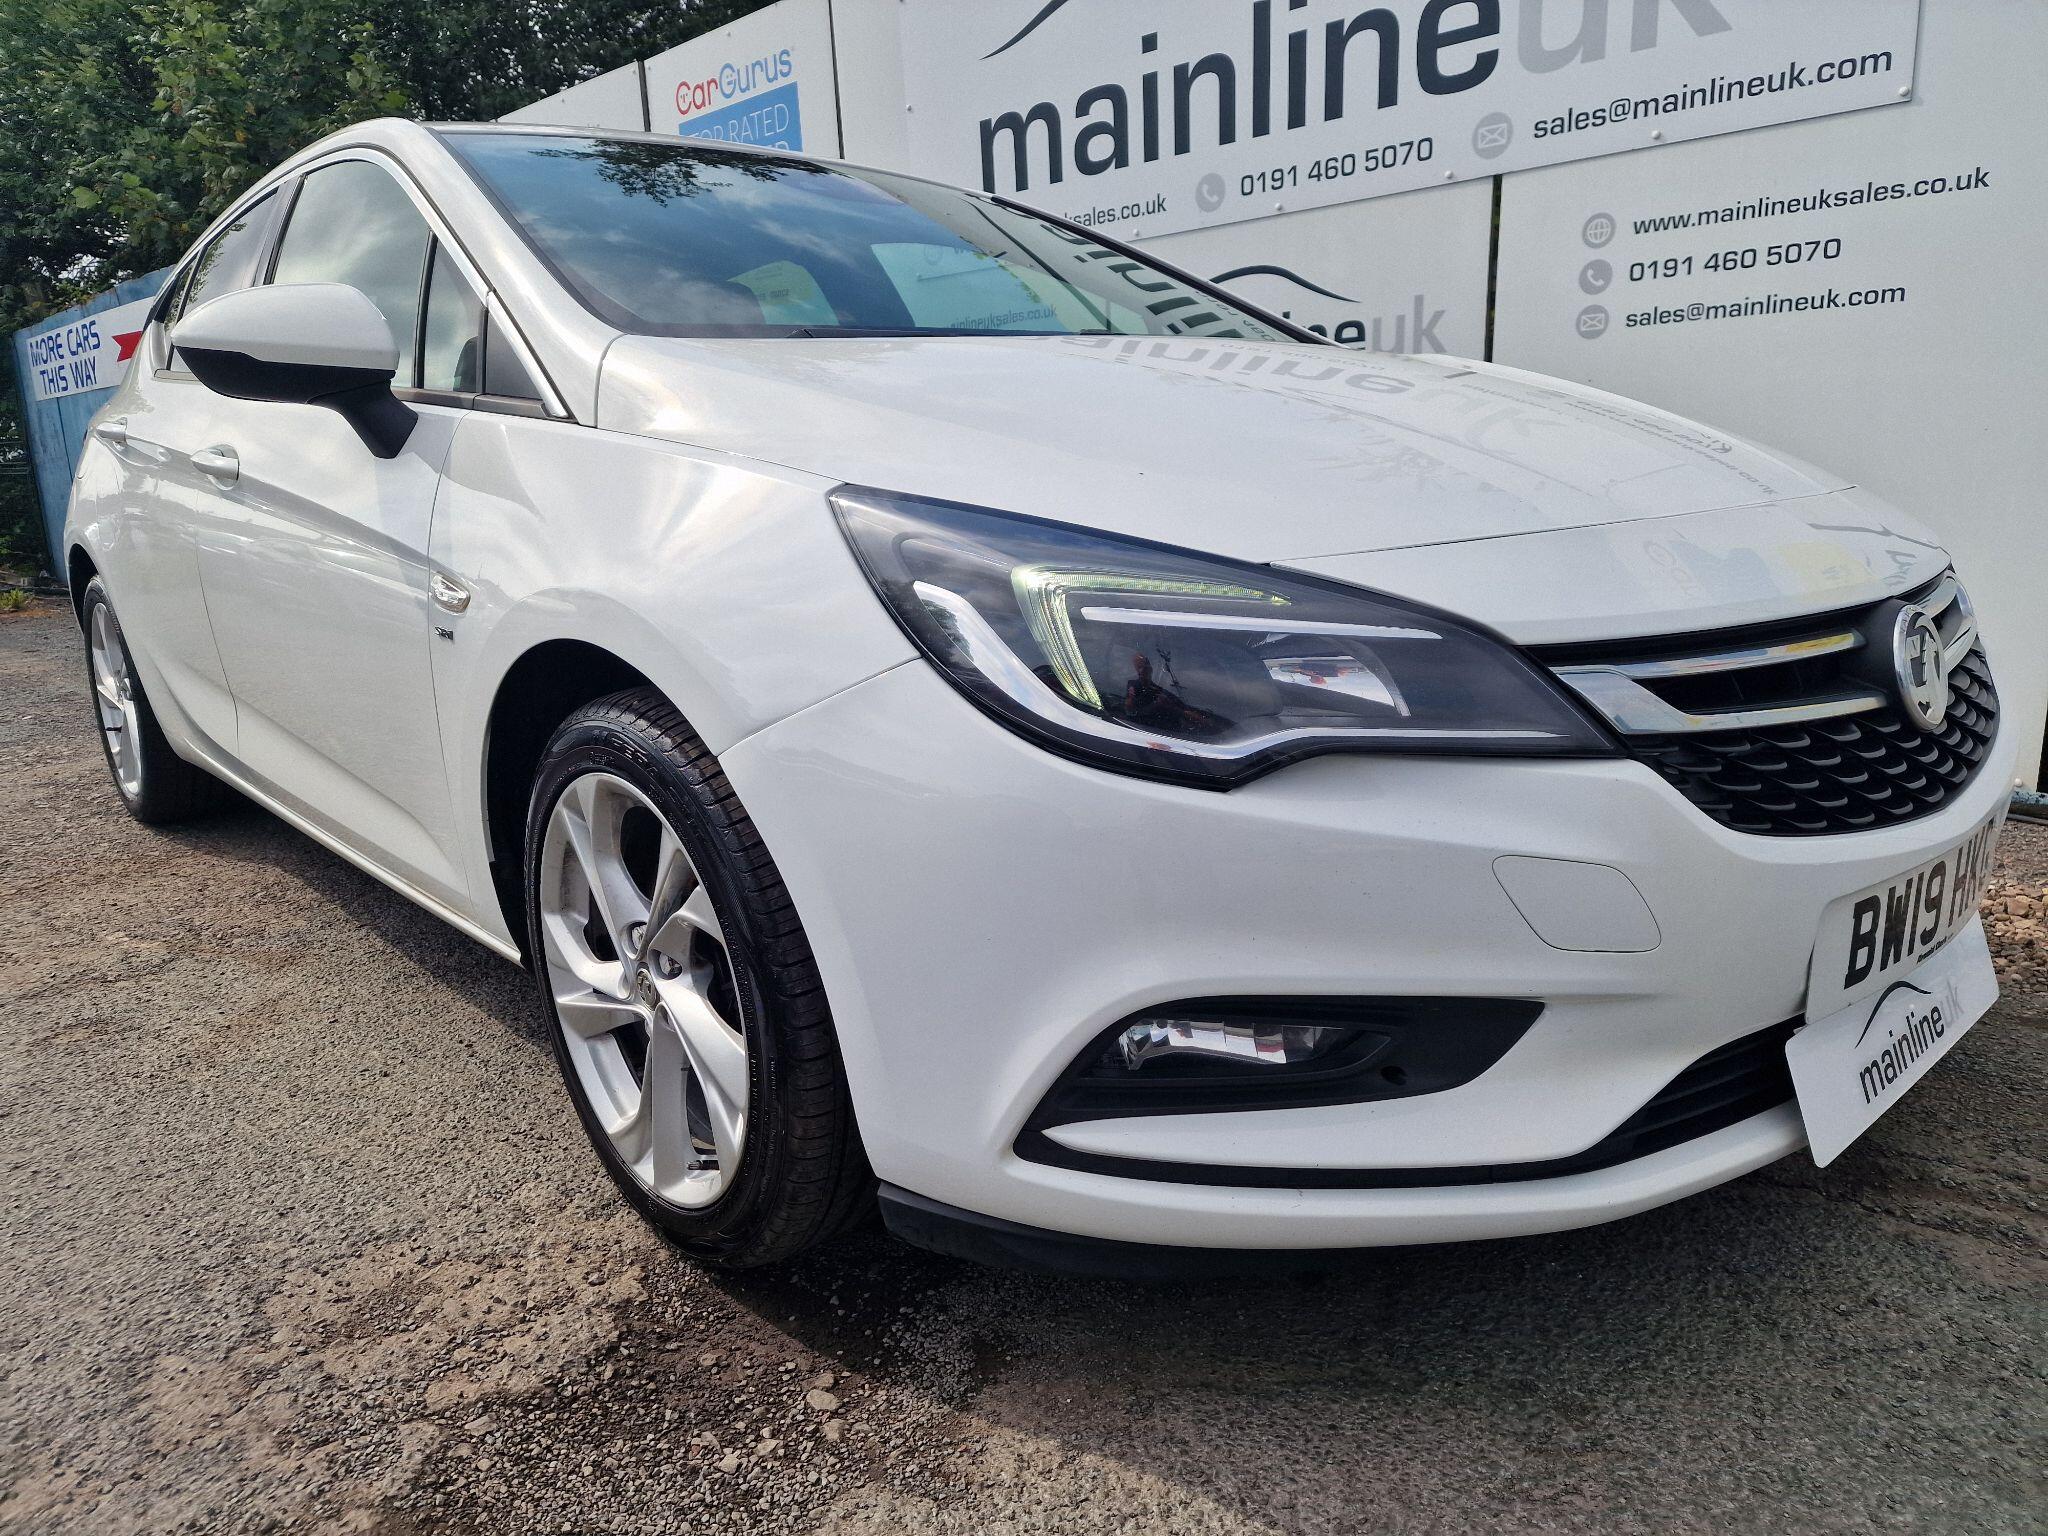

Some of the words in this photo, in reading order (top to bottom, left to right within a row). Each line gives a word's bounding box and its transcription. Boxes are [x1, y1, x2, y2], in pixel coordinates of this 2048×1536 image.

[676, 49, 792, 115] CarGurus
[1533, 50, 1893, 139] sales@mainlineuk.com
[728, 103, 789, 144] RATED
[1240, 165, 1298, 197] 0191
[1308, 153, 1356, 183] 460
[1365, 137, 1433, 172] 5070
[1633, 166, 1990, 235] www.mainlineuksales.co.uk
[1629, 256, 1694, 282] 0191
[1704, 248, 1757, 272] 460
[1766, 238, 1842, 266] 5070
[1625, 286, 1906, 328] sales@mainlineuk.com
[29, 332, 65, 368] MORE
[66, 320, 101, 357] CARS
[40, 365, 69, 395] THIS
[69, 356, 98, 389] WAY
[1843, 860, 1947, 990] BW19
